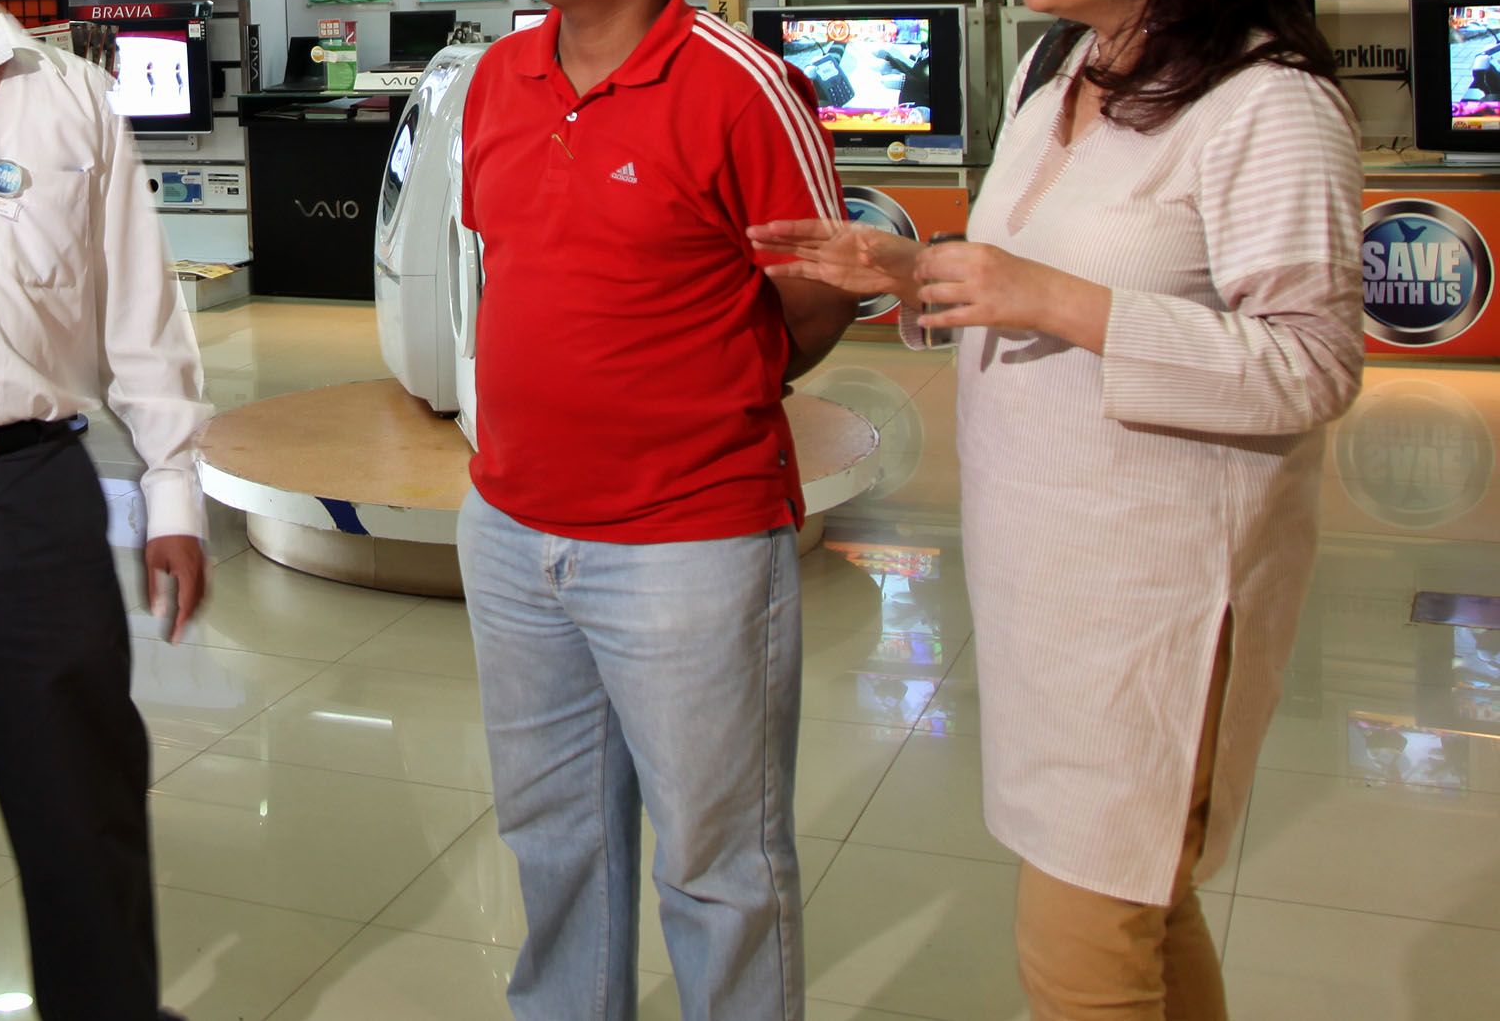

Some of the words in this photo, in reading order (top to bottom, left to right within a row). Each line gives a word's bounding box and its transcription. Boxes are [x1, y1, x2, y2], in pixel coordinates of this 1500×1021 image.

[92, 5, 152, 19] BRAVIA
[251, 36, 259, 82] VAIO
[1334, 44, 1406, 71] arkling
[381, 77, 418, 86] VAIO
[294, 199, 360, 219] VAIO
[1363, 241, 1461, 282] SAVE
[1363, 281, 1424, 305] WITH
[1430, 282, 1462, 306] US
